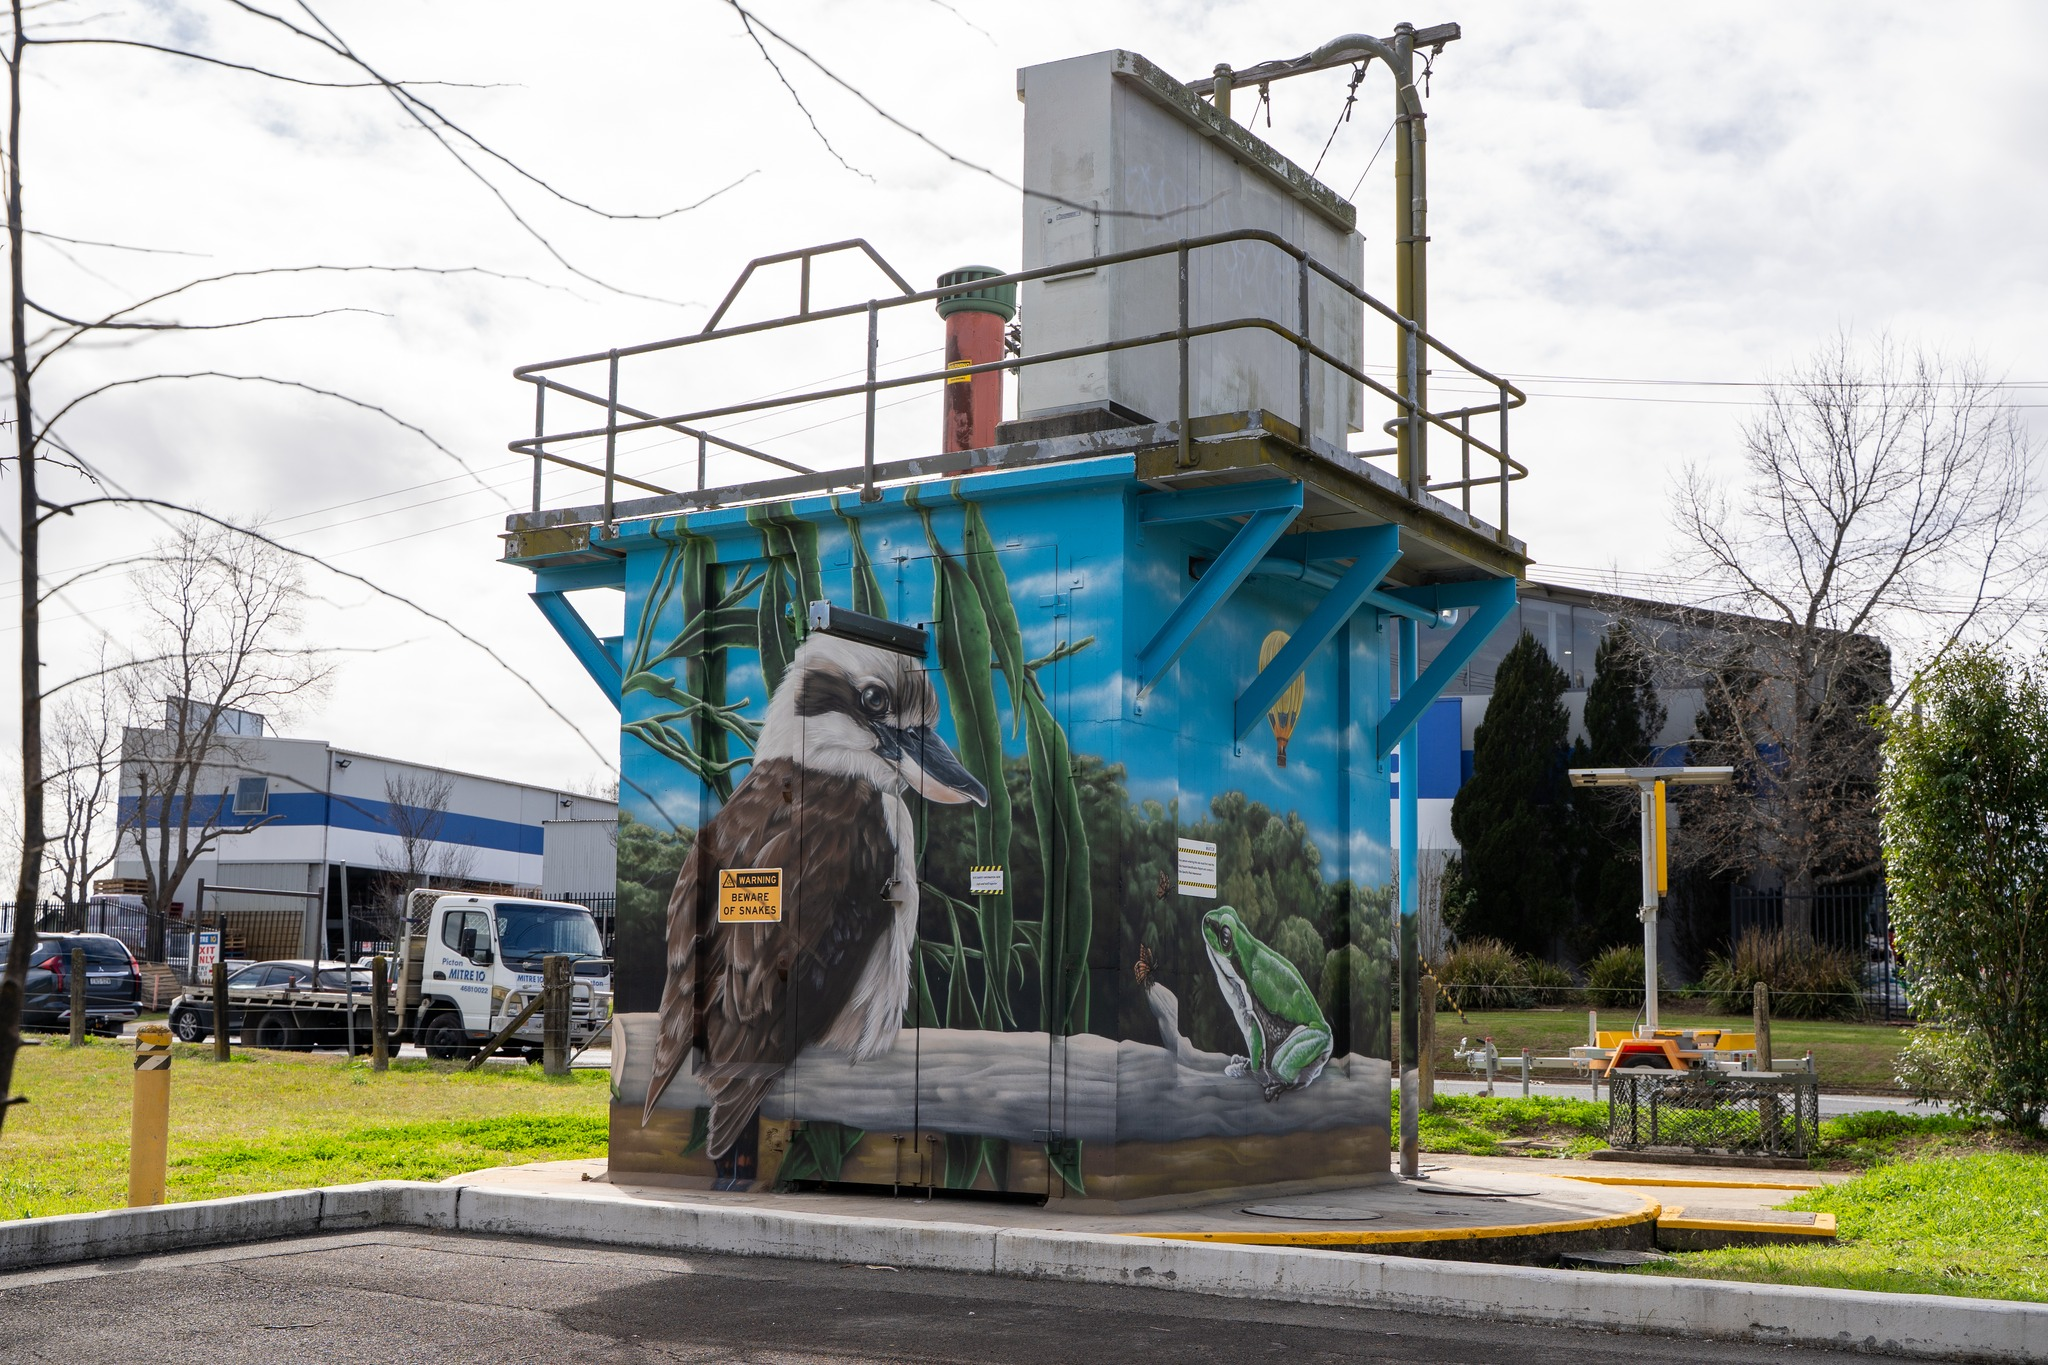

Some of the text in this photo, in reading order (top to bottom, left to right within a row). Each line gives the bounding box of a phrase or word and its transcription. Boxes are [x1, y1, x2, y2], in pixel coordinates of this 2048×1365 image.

[739, 875, 777, 885] WARNING
[731, 892, 770, 902] BEWARE
[723, 905, 777, 916] OF SNAKES
[200, 946, 215, 954] XIT
[200, 956, 215, 964] NLY
[441, 957, 464, 967] Picton
[448, 969, 486, 981] MITRE 10
[517, 974, 536, 983] MITRE
